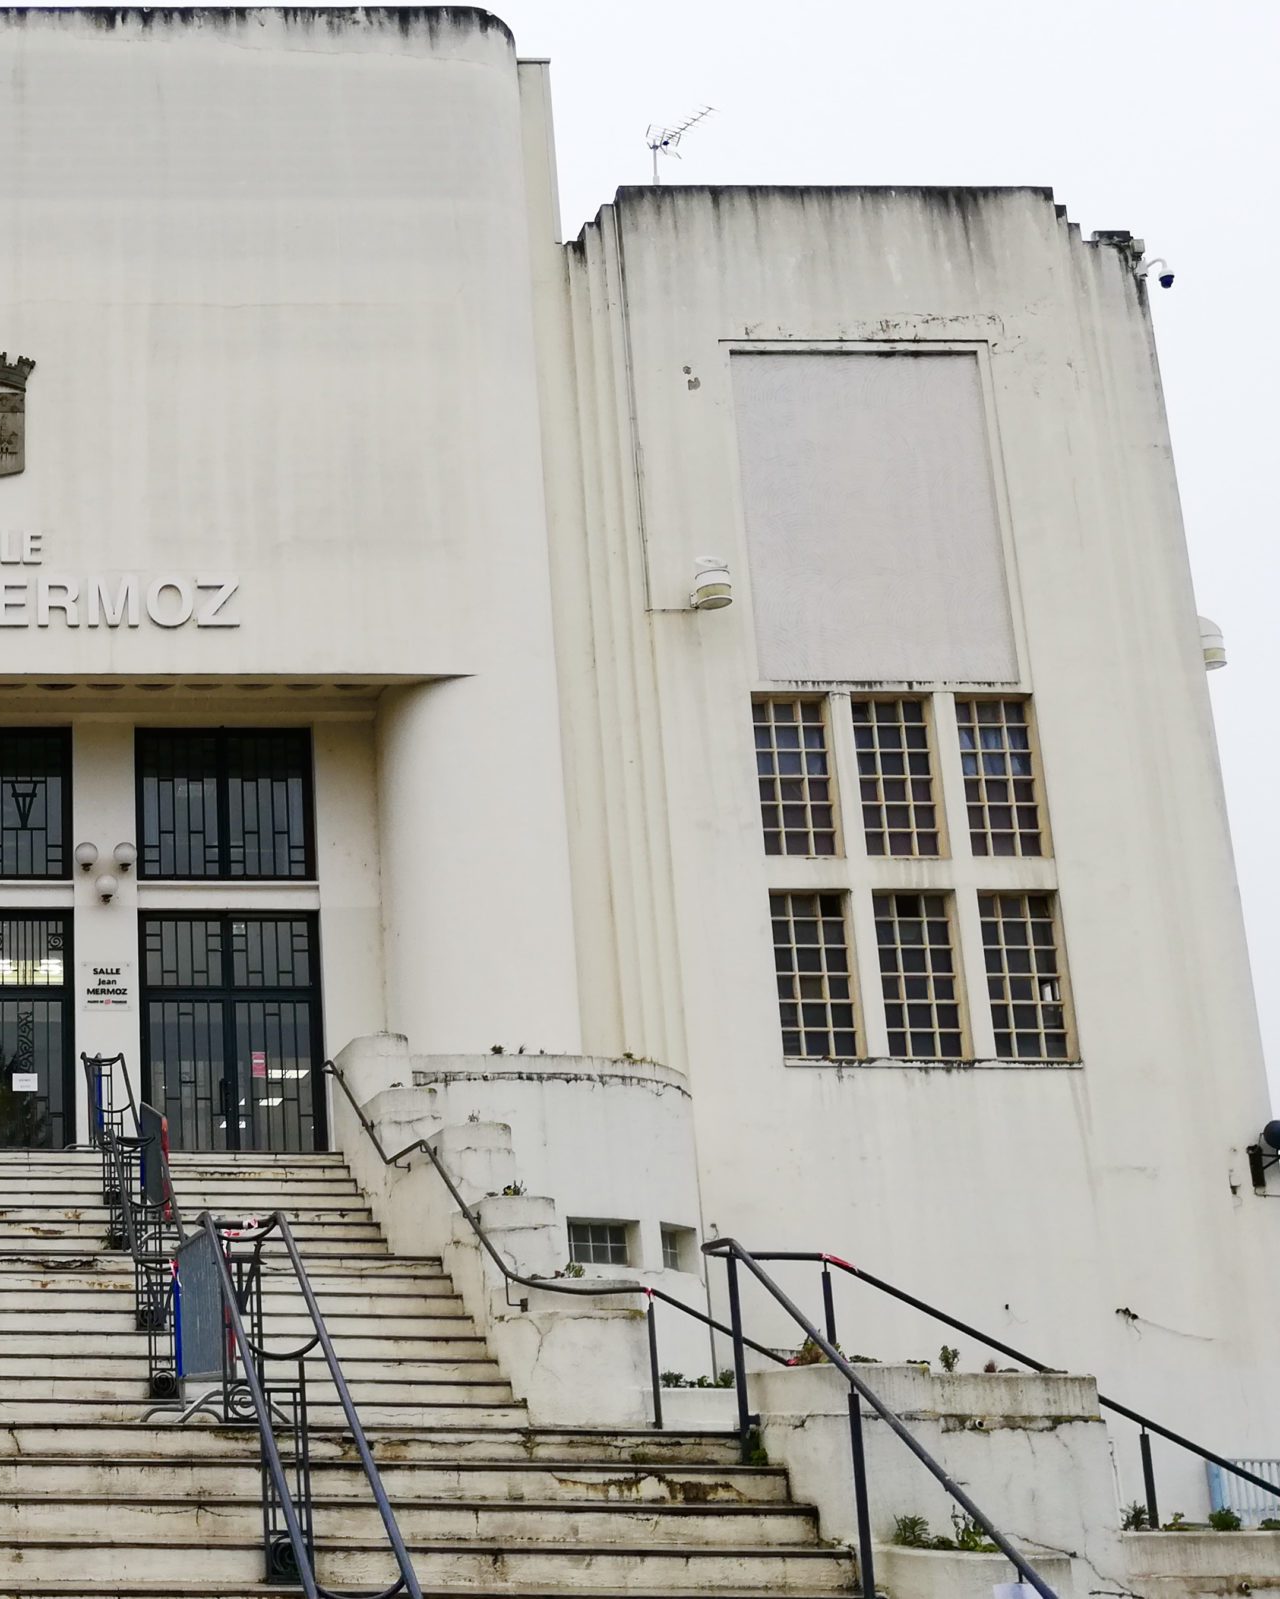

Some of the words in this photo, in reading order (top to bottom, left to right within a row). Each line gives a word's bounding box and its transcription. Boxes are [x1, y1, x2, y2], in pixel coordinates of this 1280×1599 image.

[93, 967, 121, 975] SALLE
[97, 978, 117, 986] Jean
[86, 988, 128, 996] MERMOZ
